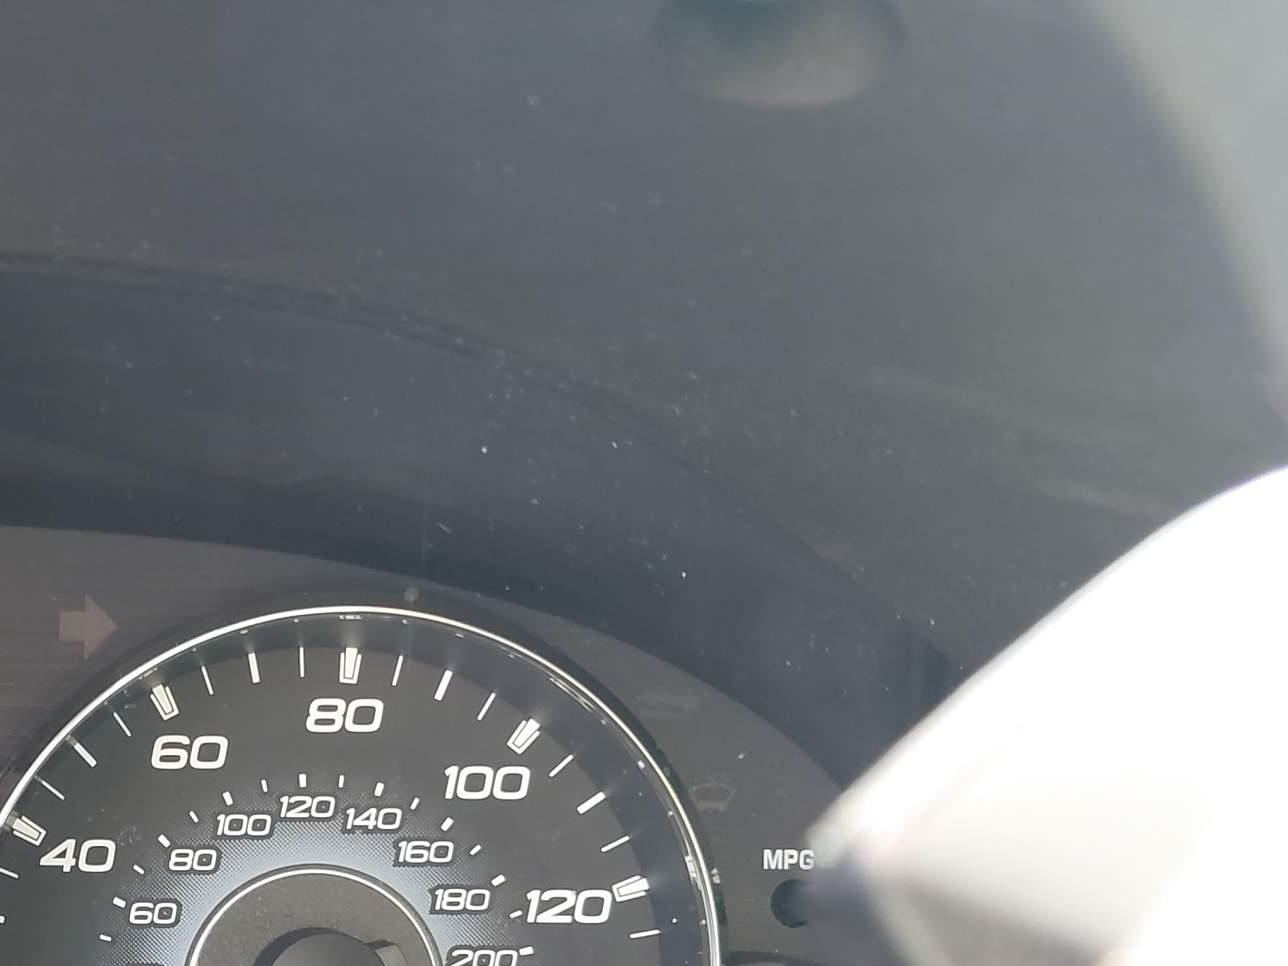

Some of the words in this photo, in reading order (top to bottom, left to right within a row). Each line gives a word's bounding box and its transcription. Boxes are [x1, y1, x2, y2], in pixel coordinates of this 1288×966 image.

[306, 699, 384, 733] 80
[151, 735, 229, 769] 60
[444, 765, 530, 800] 100
[279, 796, 335, 819] 120
[345, 807, 402, 831] 140
[216, 813, 271, 837] 100
[39, 838, 115, 874] 40
[169, 847, 217, 871] 80
[396, 839, 454, 864] 160
[762, 848, 815, 870] MPG
[432, 888, 491, 912] 180
[525, 889, 613, 925] 120
[128, 901, 179, 925] 60
